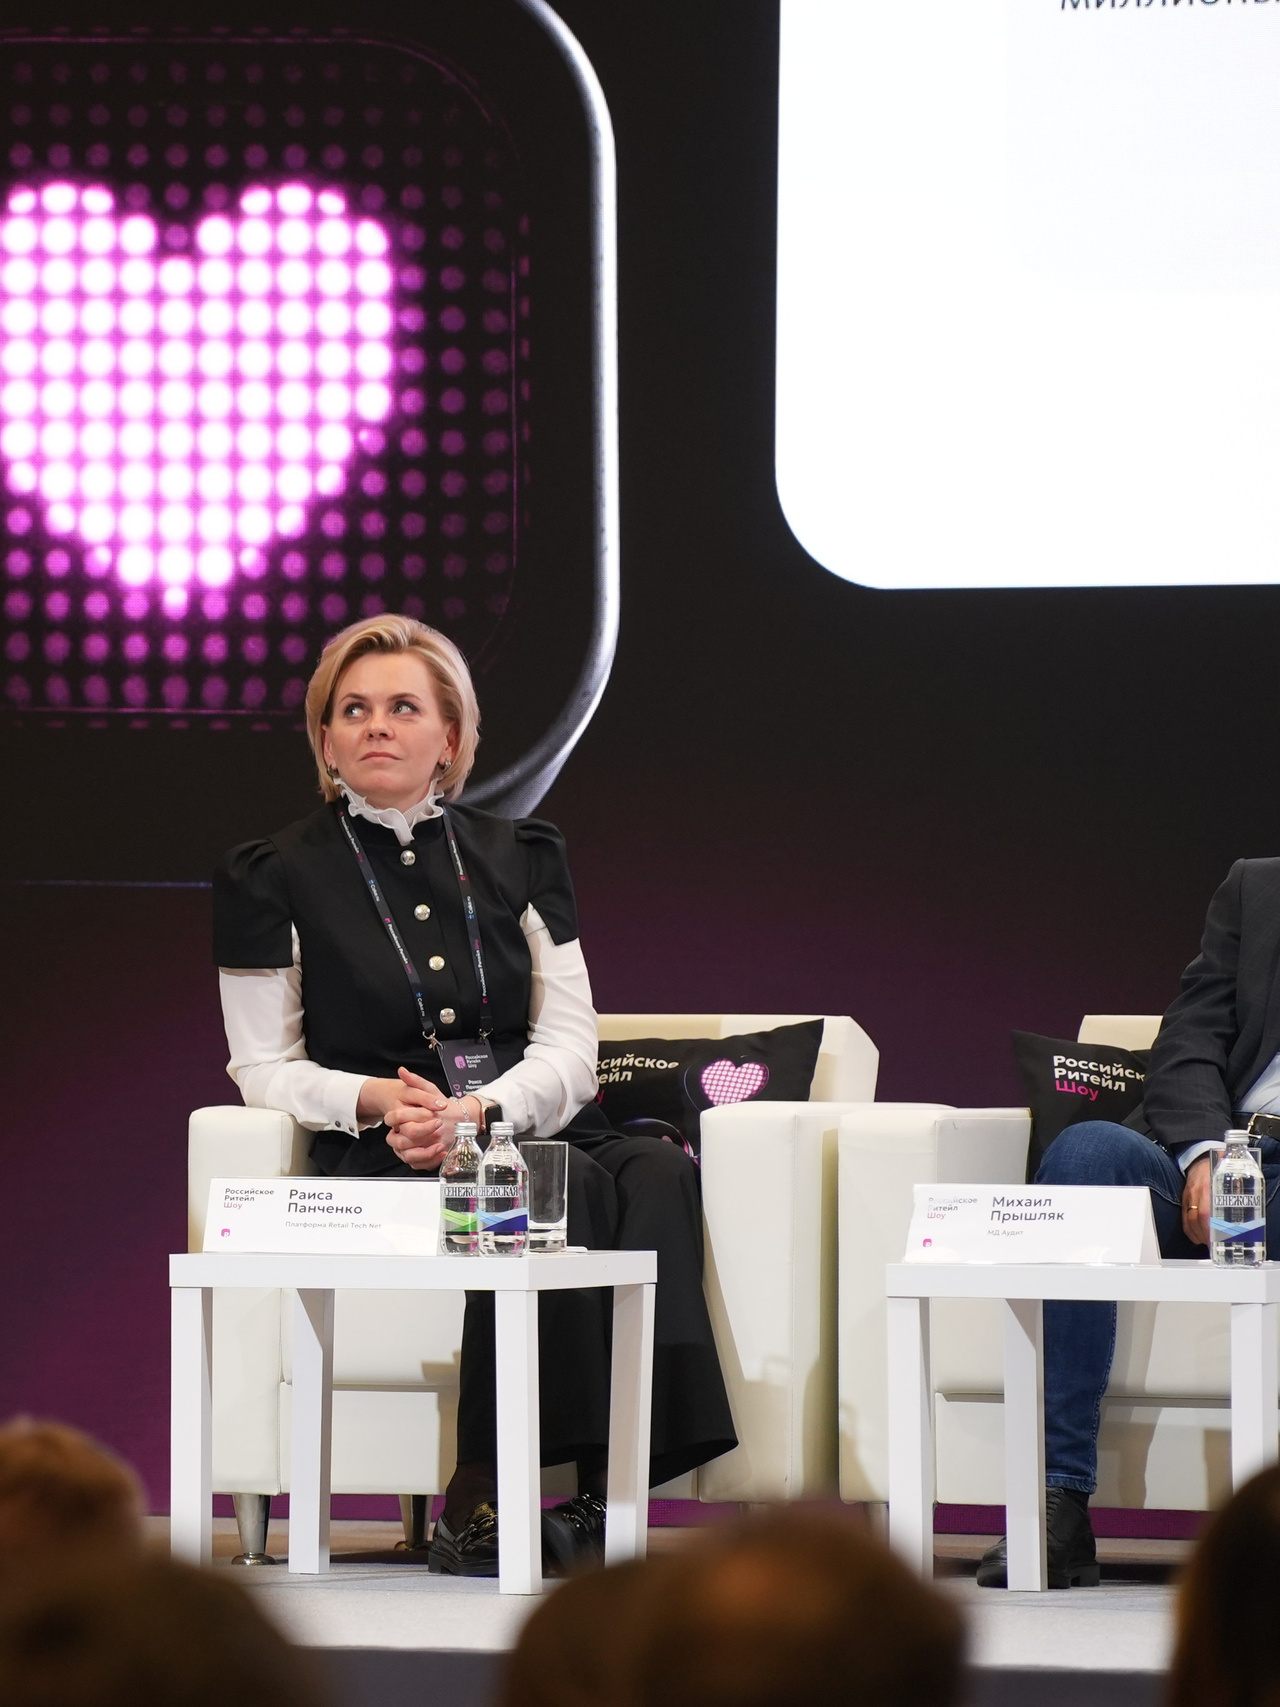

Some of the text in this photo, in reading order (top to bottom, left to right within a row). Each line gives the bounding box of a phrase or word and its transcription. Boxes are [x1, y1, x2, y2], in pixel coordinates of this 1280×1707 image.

[596, 1053, 679, 1070] сийское
[1053, 1055, 1145, 1082] Российск
[597, 1067, 633, 1084] ейл
[1054, 1067, 1126, 1092] Ритейл
[1055, 1080, 1099, 1101] Шоу
[225, 1187, 275, 1196] Российское
[289, 1189, 334, 1201] Раиса
[444, 1186, 477, 1197] СЕНЕЖС
[477, 1186, 519, 1197] ЕНЕЖСКАЯ
[224, 1194, 255, 1202] Ритейл
[992, 1196, 1052, 1208] Михаил
[1215, 1195, 1261, 1206] СЕНЕЖСКАЯ
[223, 1202, 243, 1210] Шоу
[287, 1202, 363, 1215] Панченко
[927, 1212, 946, 1221] Шоу
[990, 1210, 1065, 1224] Прышляк
